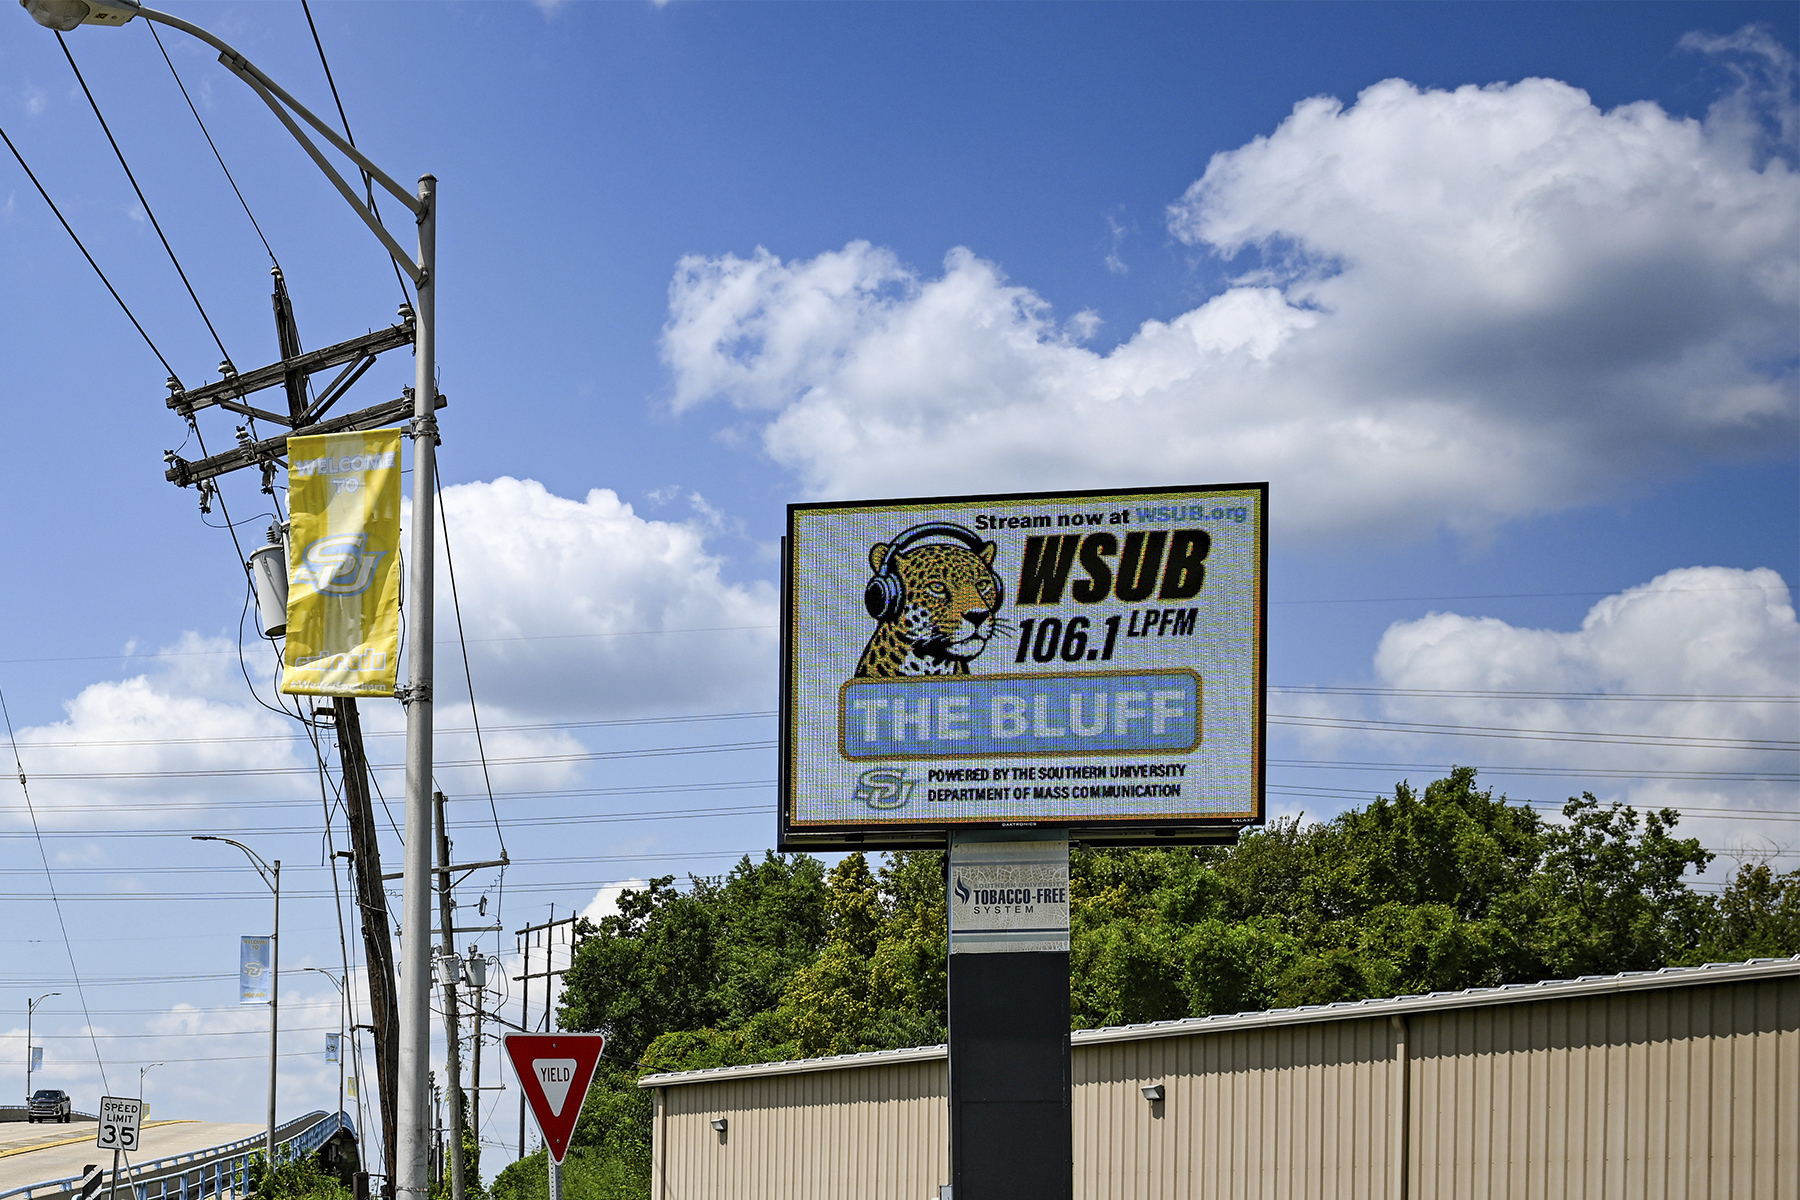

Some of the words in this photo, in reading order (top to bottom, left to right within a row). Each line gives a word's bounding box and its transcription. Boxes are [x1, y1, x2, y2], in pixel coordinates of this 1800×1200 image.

[294, 451, 395, 477] WELCOME
[332, 476, 360, 495] TO
[975, 514, 1050, 530] Stream
[1058, 512, 1103, 526] now
[1110, 509, 1129, 524] at
[1136, 505, 1247, 524] WSUB.org
[1016, 529, 1211, 605] WSUB
[1015, 615, 1122, 663] 106.1
[1127, 608, 1198, 637] LPFM
[854, 696, 971, 742] THE
[991, 689, 1186, 739] BLUFF
[928, 768, 989, 782] POWERED
[993, 768, 1009, 781] BY
[1012, 767, 1036, 780] THE
[1038, 765, 1106, 780] SOUTHERN
[1110, 764, 1186, 779] UNIVERSITY
[928, 787, 1010, 802] DEPARTMENT
[1013, 787, 1030, 800] OF
[1033, 786, 1069, 799] MASS
[1072, 784, 1181, 799] COMMUNICATION
[973, 888, 1065, 905] TOBACCO-FREE
[973, 905, 1034, 914] SYSTEM
[541, 1067, 570, 1082] YIELD
[104, 1102, 138, 1113] SPEED
[107, 1113, 133, 1123] LIMIT
[101, 1124, 134, 1145] 35
